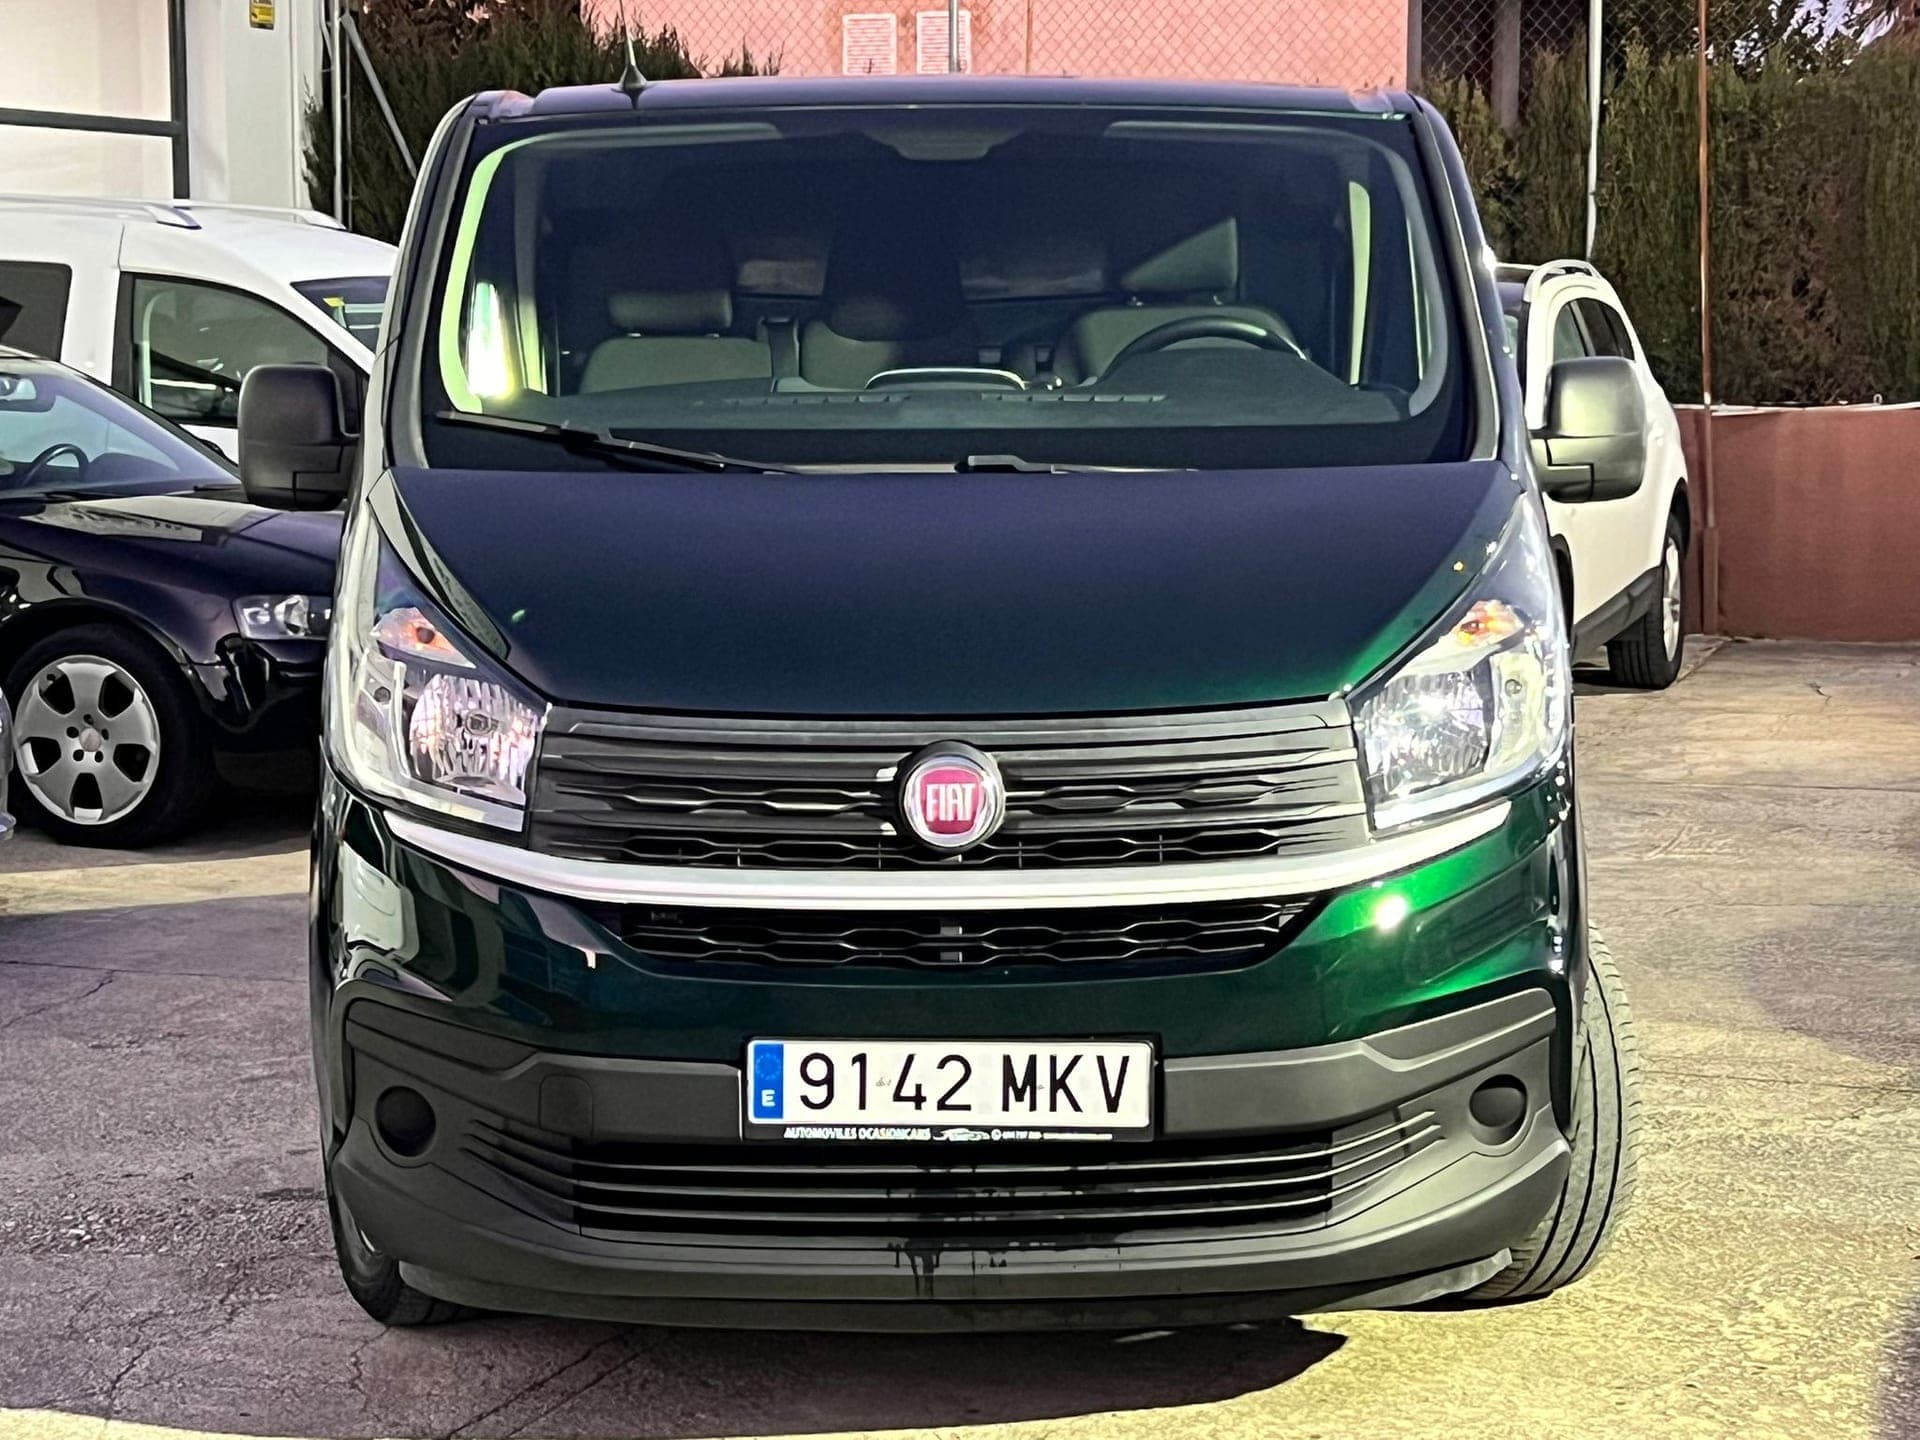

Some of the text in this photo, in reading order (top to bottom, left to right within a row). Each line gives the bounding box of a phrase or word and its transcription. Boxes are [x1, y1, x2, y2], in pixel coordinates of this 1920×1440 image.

[926, 783, 977, 822] FIAT
[799, 1052, 1131, 1113] 9142 MKV
[761, 1089, 776, 1107] E
[783, 1127, 857, 1139] AUTOMOVILES
